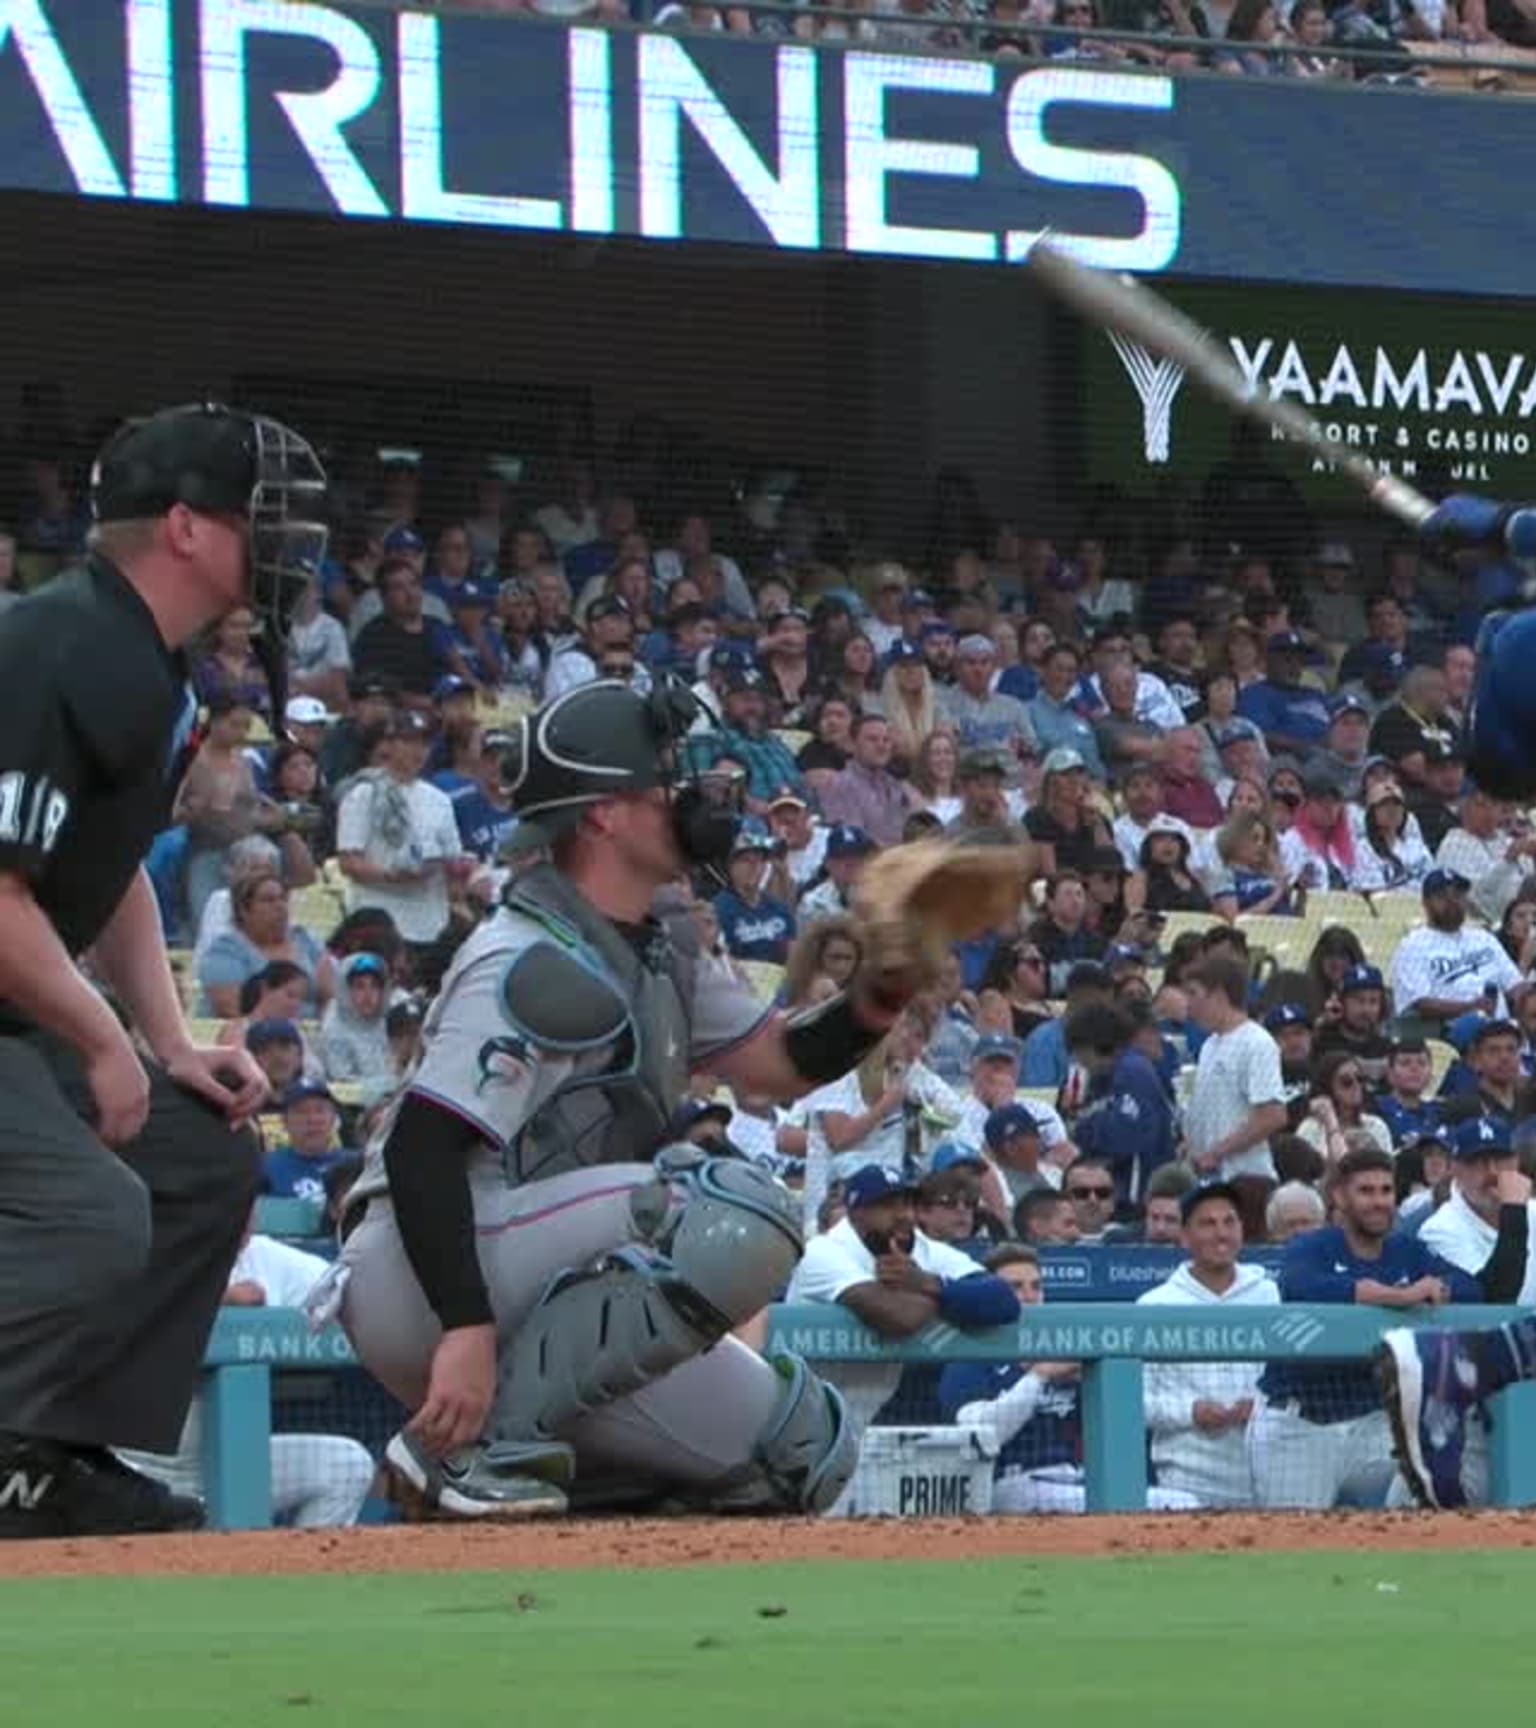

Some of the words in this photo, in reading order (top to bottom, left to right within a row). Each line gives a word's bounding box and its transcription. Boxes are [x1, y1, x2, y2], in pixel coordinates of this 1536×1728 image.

[1271, 422, 1378, 446] RSORT
[1396, 427, 1411, 447] &
[1426, 429, 1530, 455] CASINO
[238, 1333, 323, 1360] BANK
[332, 1333, 358, 1360] O
[771, 1327, 881, 1353] AMERIC
[1018, 1326, 1093, 1352] BANK
[1101, 1327, 1136, 1352] OF
[1143, 1327, 1267, 1353] AMERICA
[899, 1474, 970, 1514] PRIME
